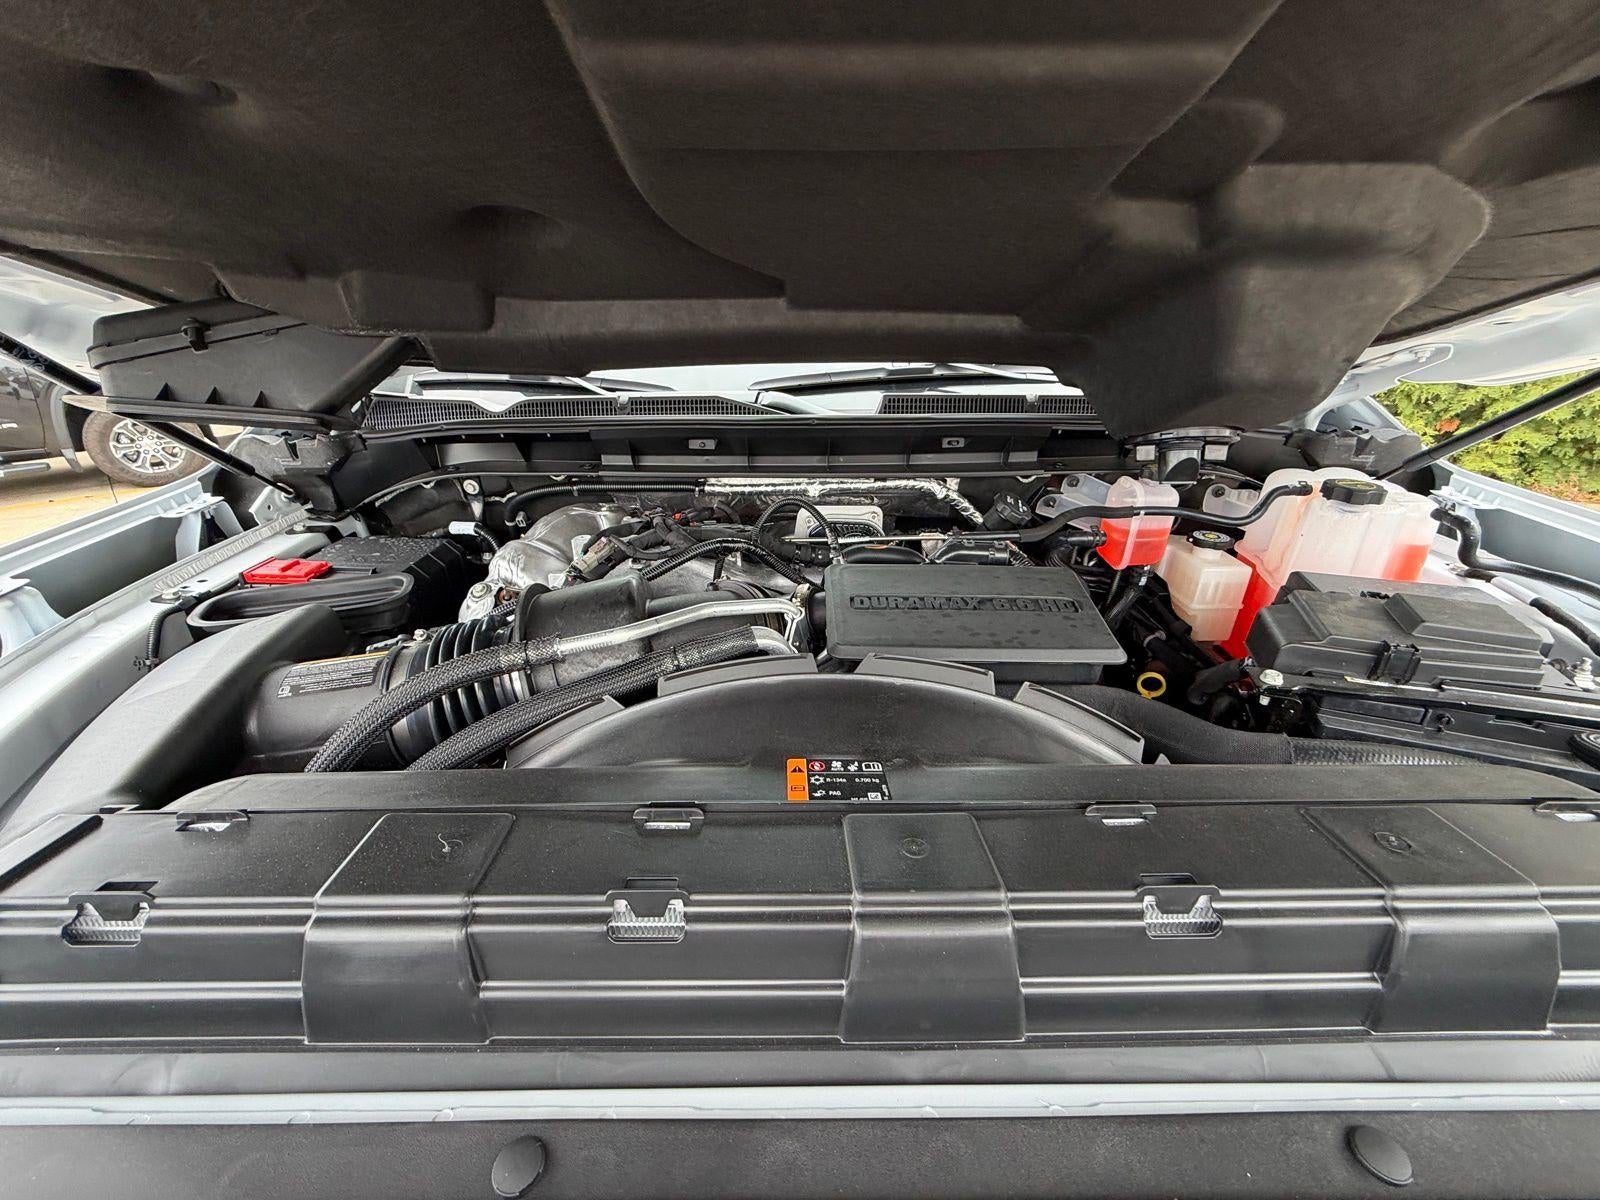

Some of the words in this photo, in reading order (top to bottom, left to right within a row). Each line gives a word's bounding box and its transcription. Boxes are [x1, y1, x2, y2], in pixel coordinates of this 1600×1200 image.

[852, 596, 980, 610] DURAMAX
[992, 597, 1034, 611] 6.6
[1037, 599, 1079, 612] HD
